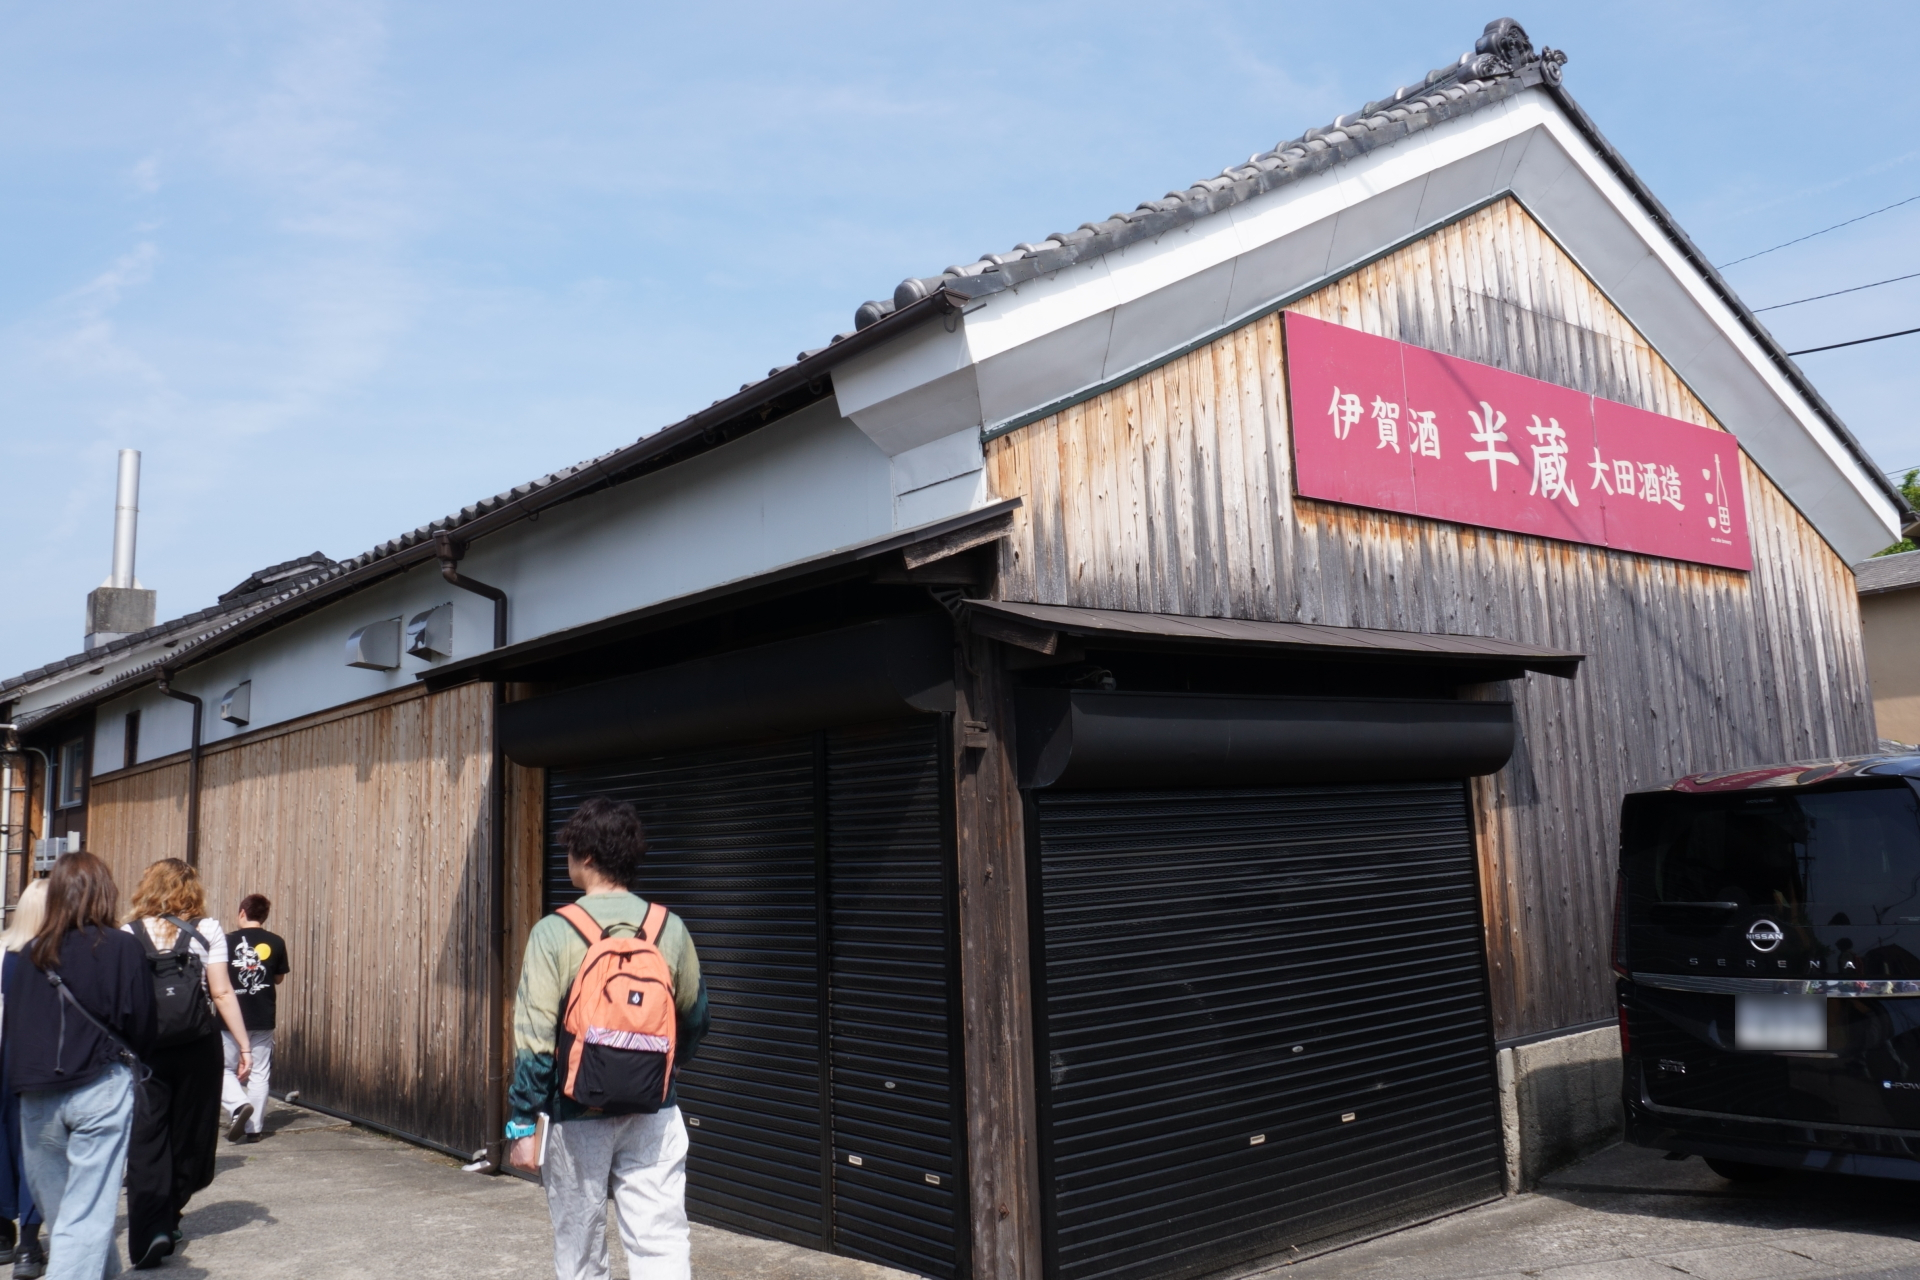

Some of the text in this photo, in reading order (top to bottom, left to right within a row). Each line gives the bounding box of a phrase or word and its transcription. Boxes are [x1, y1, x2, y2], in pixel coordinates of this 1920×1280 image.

[1328, 386, 1685, 512] 伊賀酒 半蔵 大田酒造
[1689, 957, 1857, 970] SERENA
